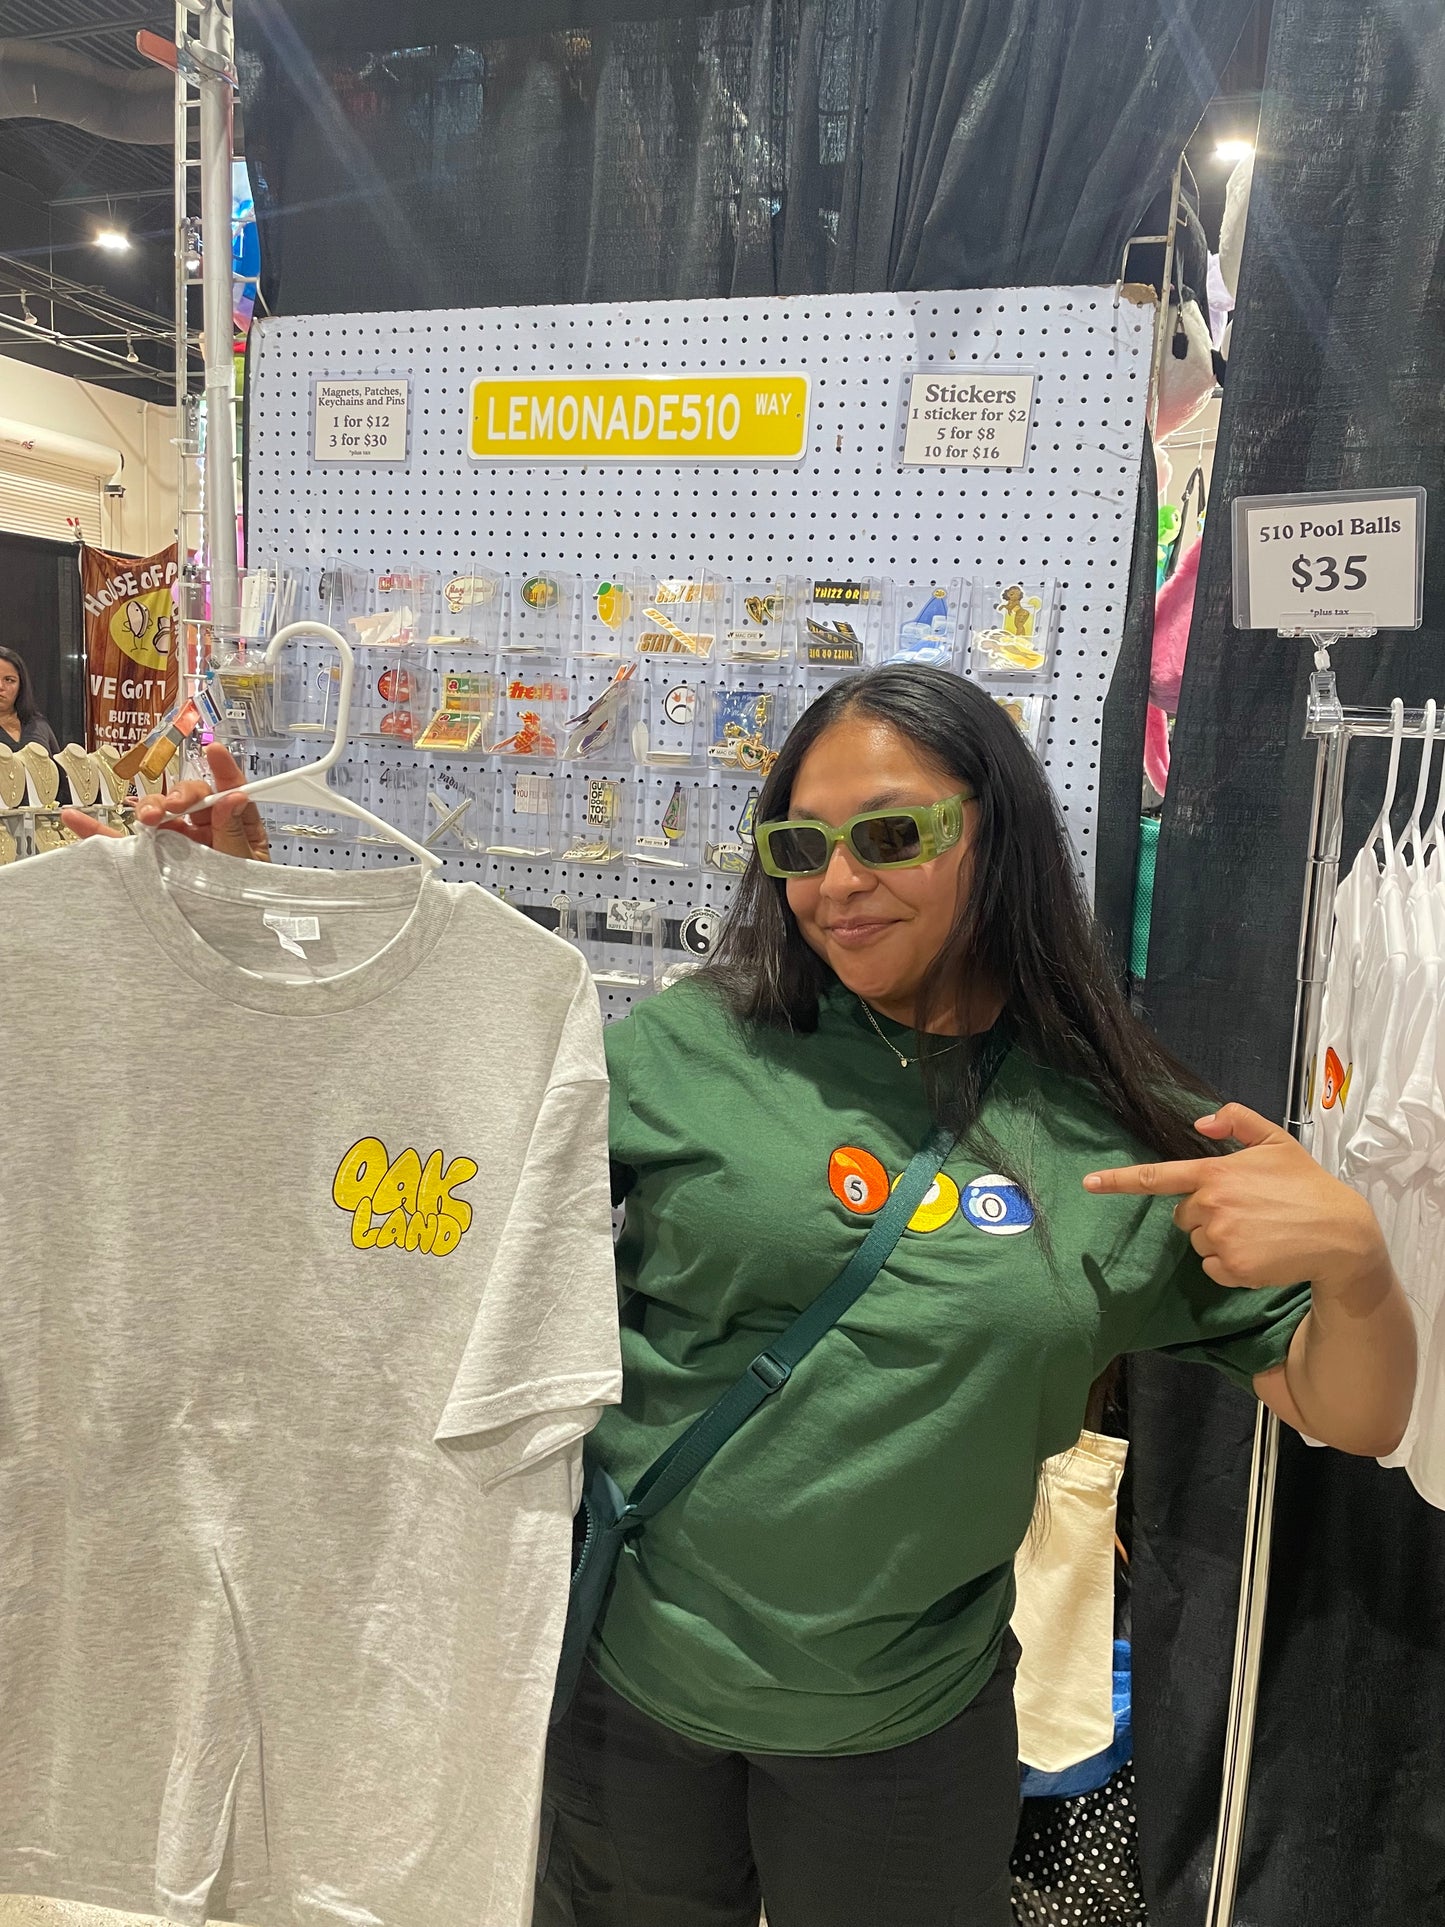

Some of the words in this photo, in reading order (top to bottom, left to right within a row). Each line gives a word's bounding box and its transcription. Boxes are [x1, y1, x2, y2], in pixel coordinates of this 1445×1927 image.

[322, 388, 362, 398] Magnets,
[364, 386, 402, 397] Patches,
[925, 384, 1017, 404] Stickers
[318, 397, 364, 408] Keychains
[366, 397, 383, 406] and
[386, 396, 405, 405] Pins
[333, 416, 339, 428] 1
[343, 415, 362, 428] for
[366, 415, 390, 429] $12
[488, 393, 741, 440] LEMONADE510
[755, 393, 792, 416] WAY
[912, 408, 919, 419] 1
[924, 407, 977, 421] sticker
[980, 408, 1004, 421] for
[1008, 409, 1026, 423] $2
[329, 434, 337, 447] 3
[341, 433, 360, 446] for
[364, 433, 387, 447] $30
[937, 427, 946, 440] 5
[950, 426, 973, 439] for
[977, 427, 995, 441] $8
[925, 446, 941, 457] 10
[945, 445, 968, 458] for
[972, 446, 1000, 460] $16
[1259, 525, 1294, 543] 510
[1300, 519, 1344, 539] Pool
[1350, 516, 1401, 535] Balls
[1291, 554, 1368, 593] $35
[84, 571, 139, 618] HOUSE
[140, 564, 164, 590] OF
[815, 587, 843, 599] THIZZ
[845, 588, 860, 600] OR
[641, 633, 673, 652] STAY
[834, 649, 854, 660] THIZZ
[122, 680, 153, 700] GOT
[109, 710, 151, 726] BUTTER
[591, 791, 603, 799] OF
[333, 1136, 479, 1235] OAK
[850, 1180, 863, 1202] 5
[981, 1197, 1002, 1218] 0
[351, 1196, 463, 1257] LAND
